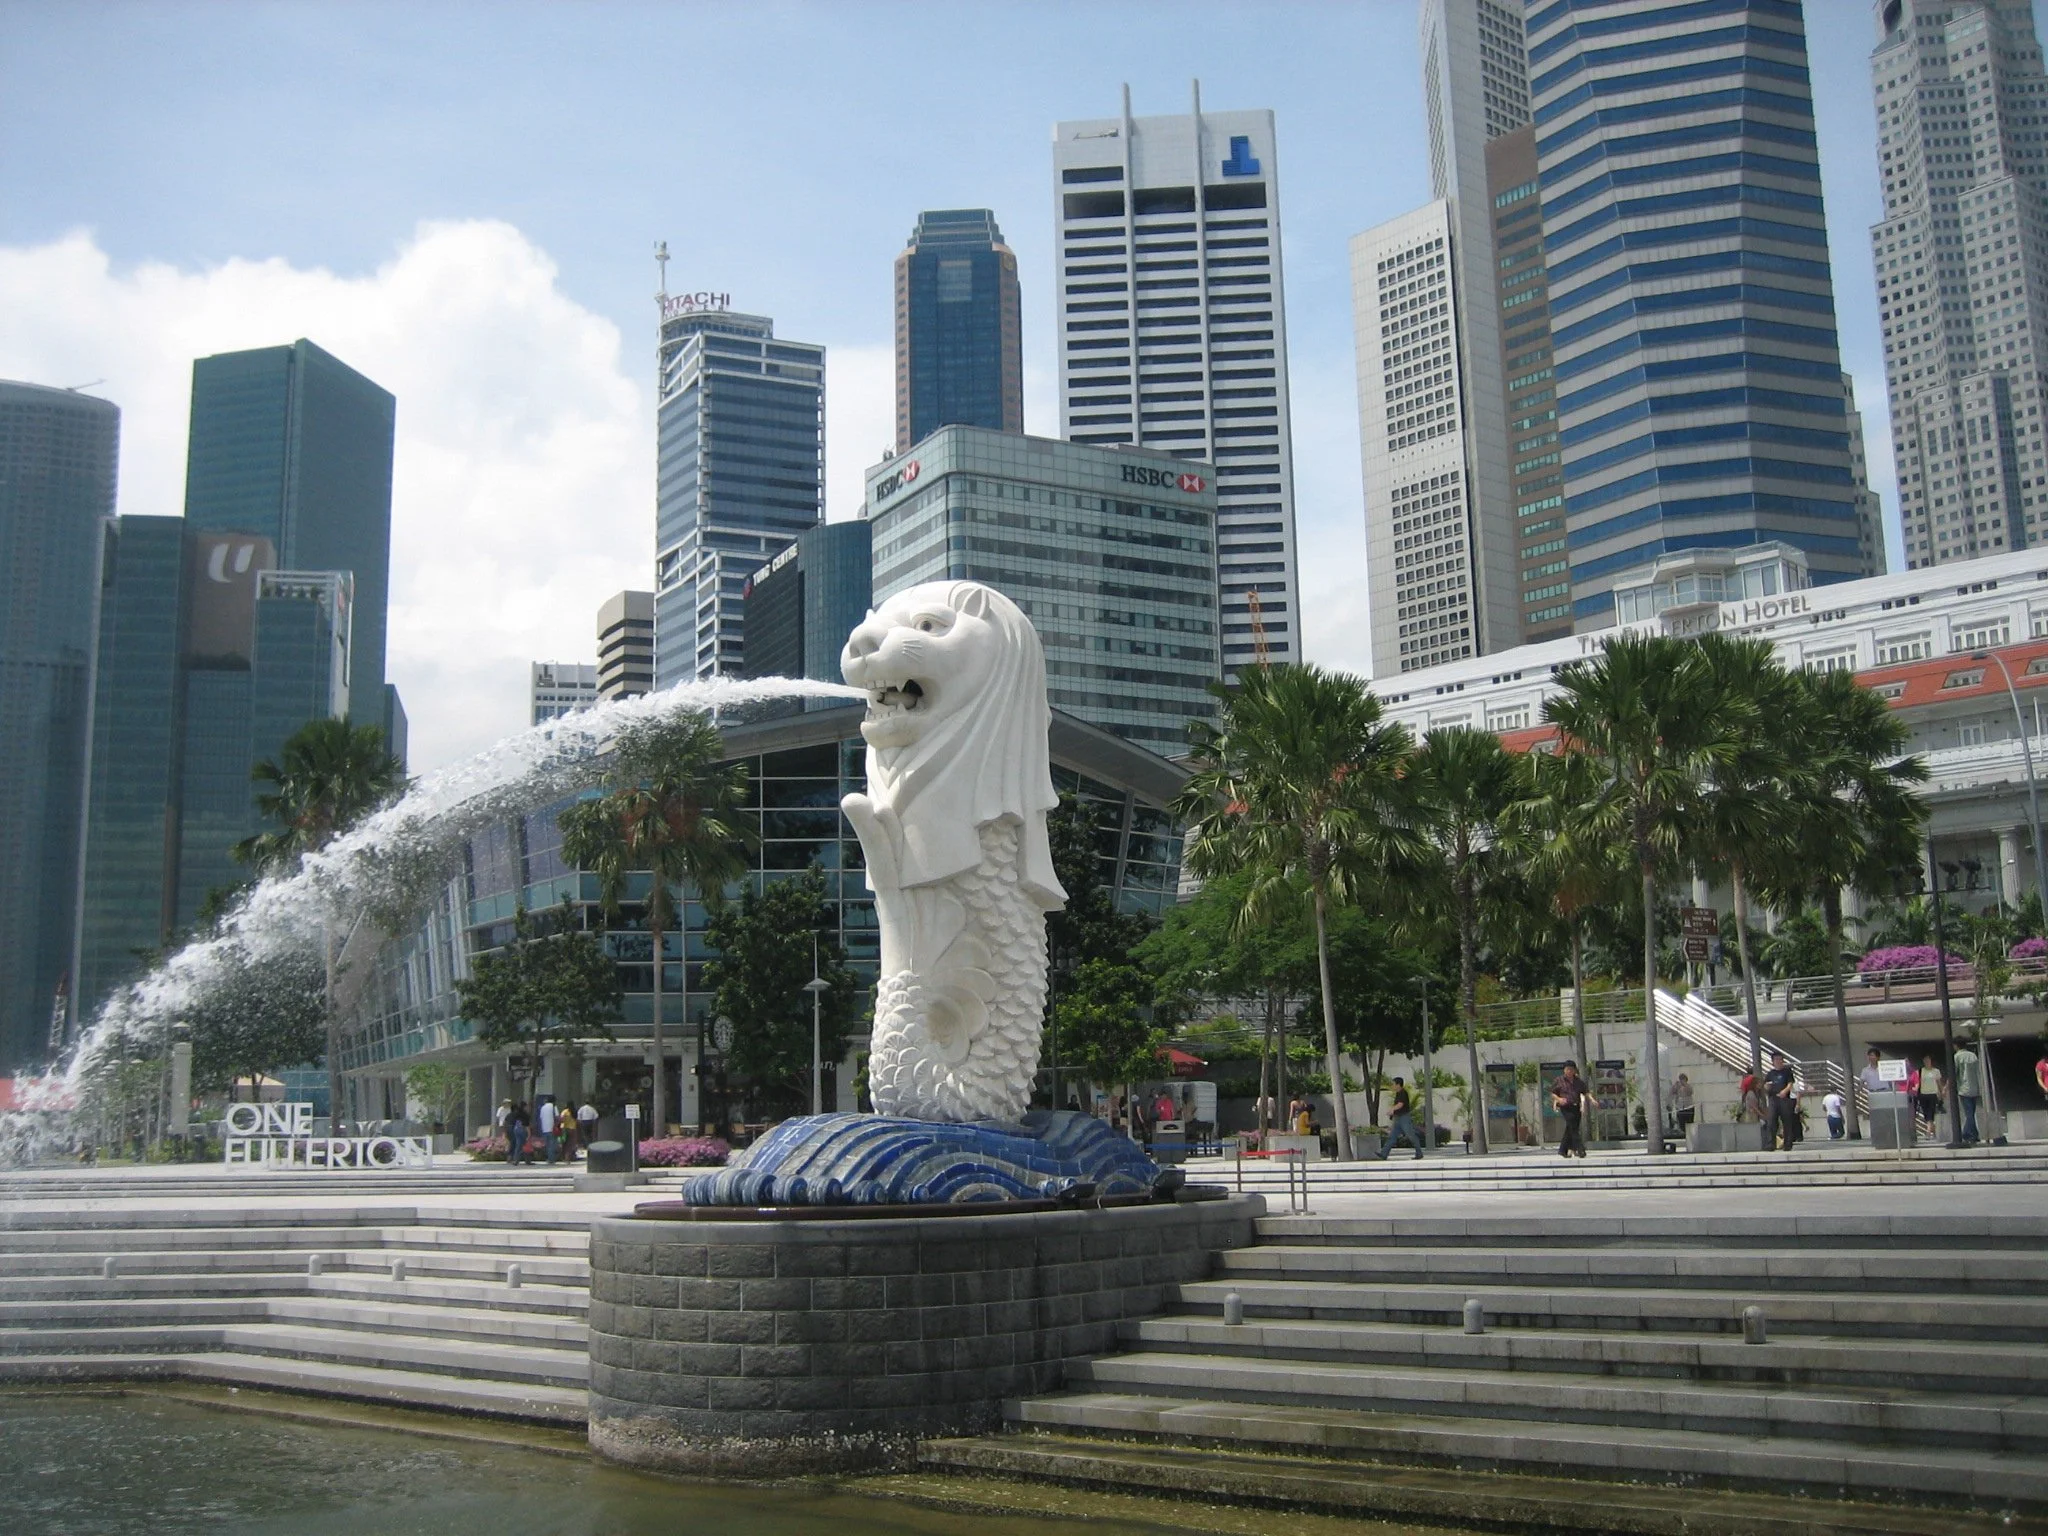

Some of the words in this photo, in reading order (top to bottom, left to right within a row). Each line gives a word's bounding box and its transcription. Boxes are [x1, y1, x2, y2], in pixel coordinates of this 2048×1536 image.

[664, 292, 730, 312] HITACHI
[876, 470, 903, 502] HSBC
[1121, 464, 1174, 488] HSBC
[1743, 595, 1811, 624] HOTEL
[226, 1102, 313, 1136] ONE
[226, 1136, 433, 1171] FULLERTON
